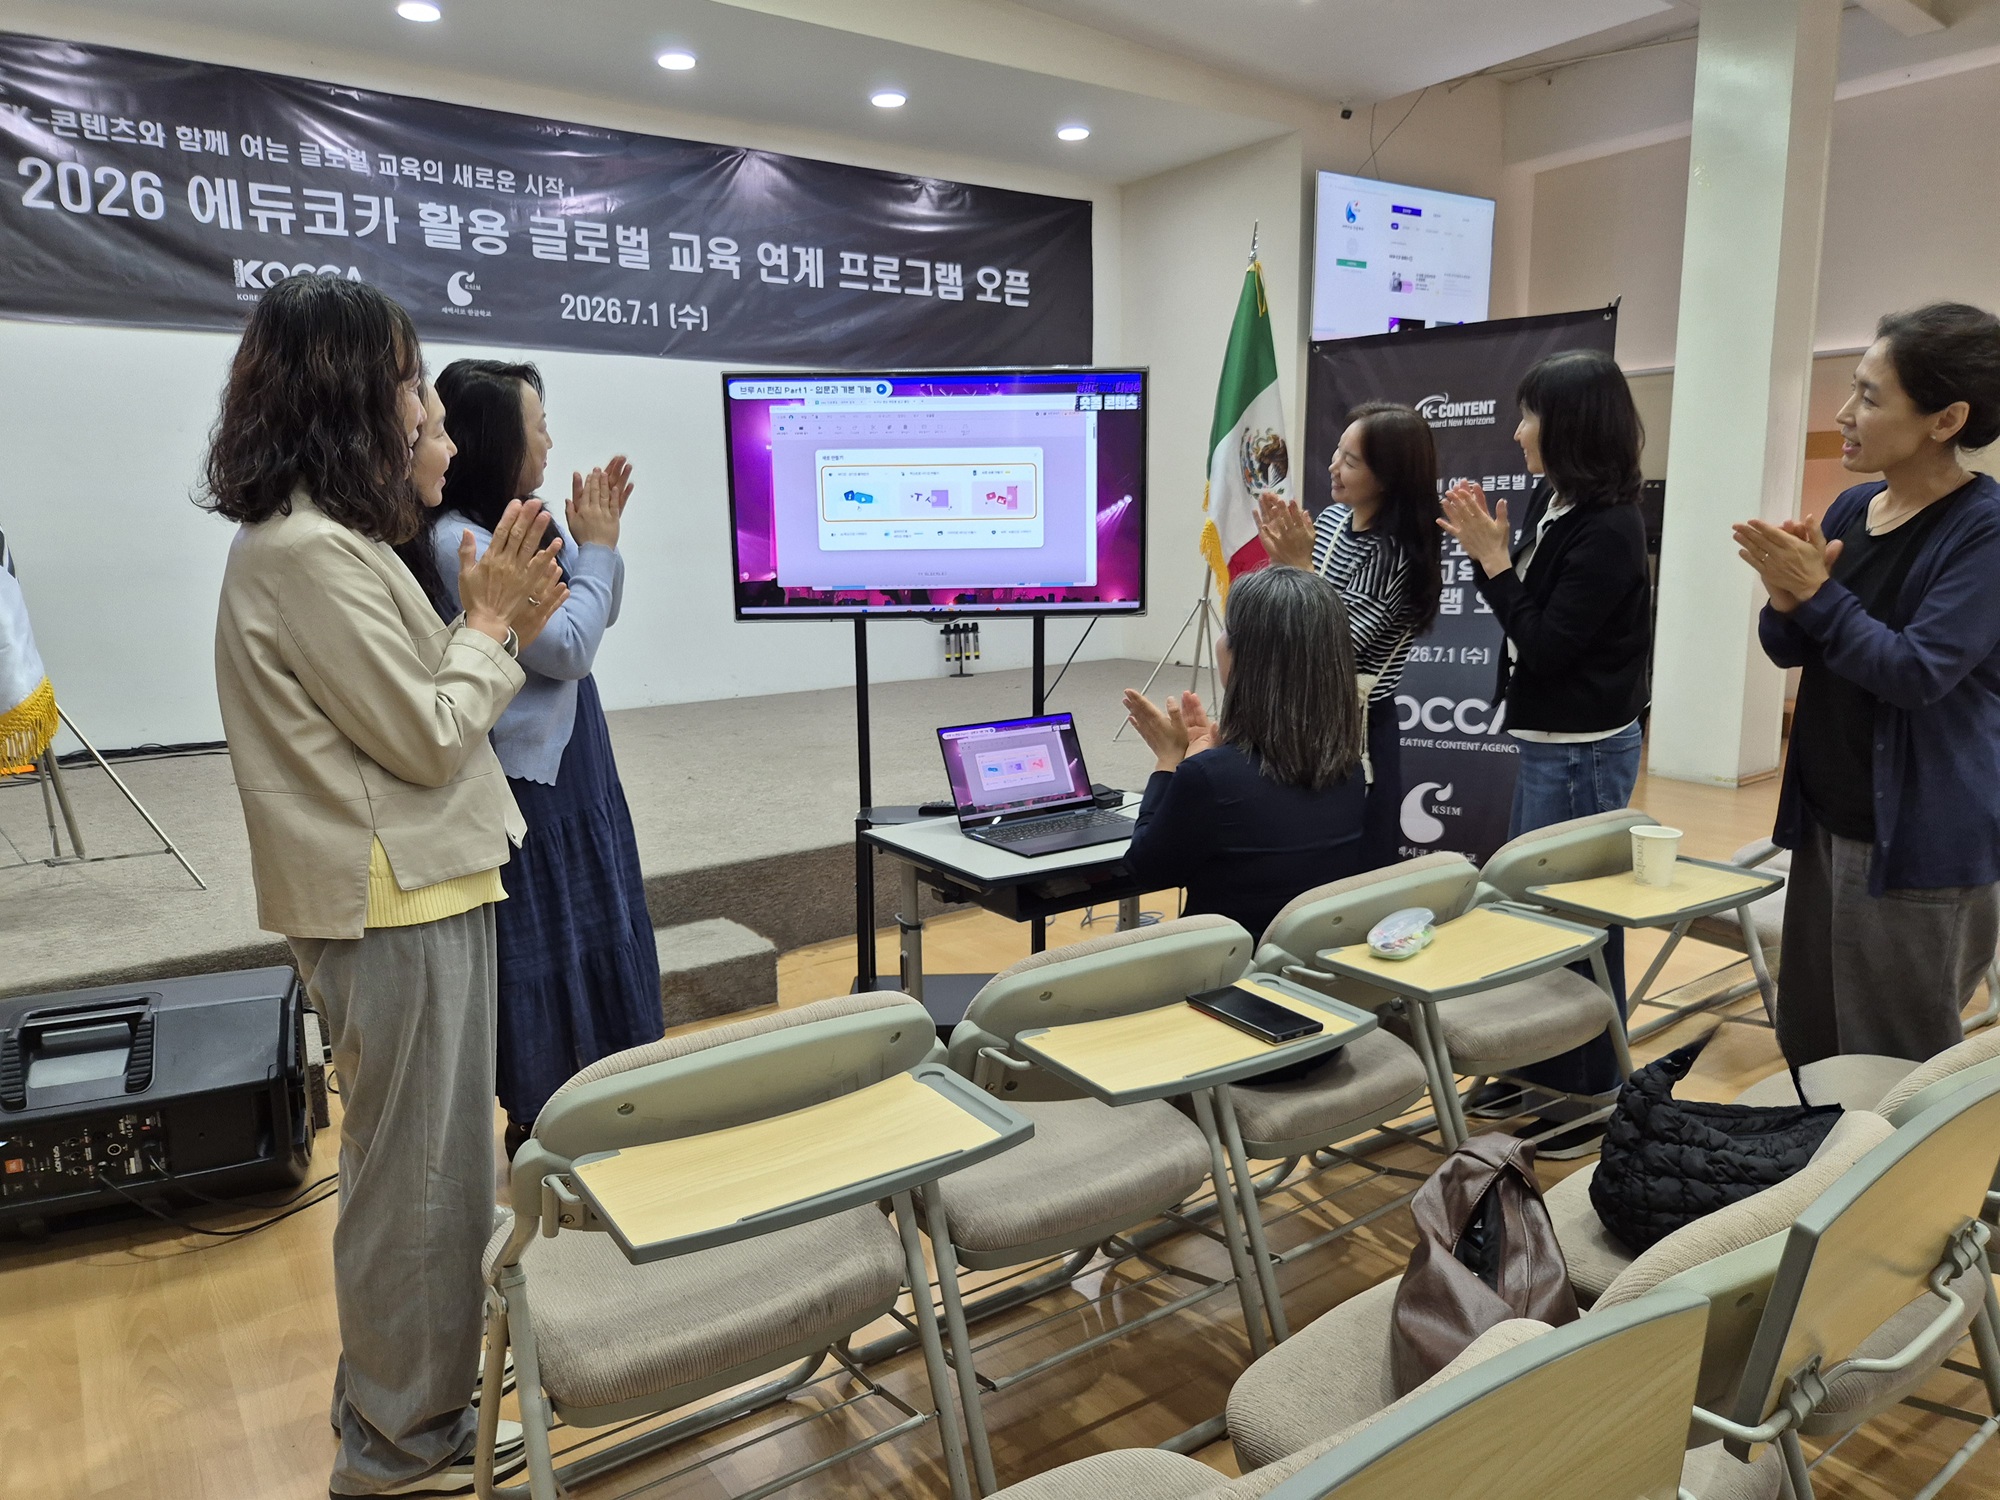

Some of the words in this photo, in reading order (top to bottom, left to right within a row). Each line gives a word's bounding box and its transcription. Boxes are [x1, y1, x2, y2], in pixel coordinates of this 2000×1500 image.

[175, 125, 230, 156] 함께
[239, 133, 289, 163] 여는
[299, 141, 371, 177] 글로벌
[377, 153, 444, 185] 교육의
[452, 163, 516, 194] 새로운
[17, 156, 165, 221] 2026
[187, 174, 400, 245] 에듀코카
[418, 201, 510, 256] 활용
[528, 215, 651, 271] 글로벌
[668, 231, 741, 280] 교육
[756, 241, 824, 289] 연계
[838, 251, 964, 301] 프로그램
[975, 266, 1031, 308] 오픈
[236, 293, 262, 302] KORE
[560, 293, 659, 327] 2026.7.1
[669, 302, 709, 332] (수)
[740, 386, 755, 395] 브루
[757, 386, 765, 394] AI
[767, 386, 782, 395] 편집
[815, 385, 839, 394] 입문과
[841, 385, 855, 394] 기본
[858, 385, 872, 394] 기능
[1422, 399, 1497, 419] K-CONTENT
[1428, 418, 1447, 428] ward
[1448, 418, 1463, 428] New
[1464, 416, 1496, 426] Horizons
[1481, 473, 1527, 491] 글로벌
[1409, 645, 1456, 664] 26.7.1
[1460, 646, 1491, 665] (수)
[1399, 737, 1434, 748] EATIVE
[1435, 739, 1481, 751] CONTENT
[1431, 804, 1462, 816] KSIM
[1397, 846, 1428, 858] 멕시코
